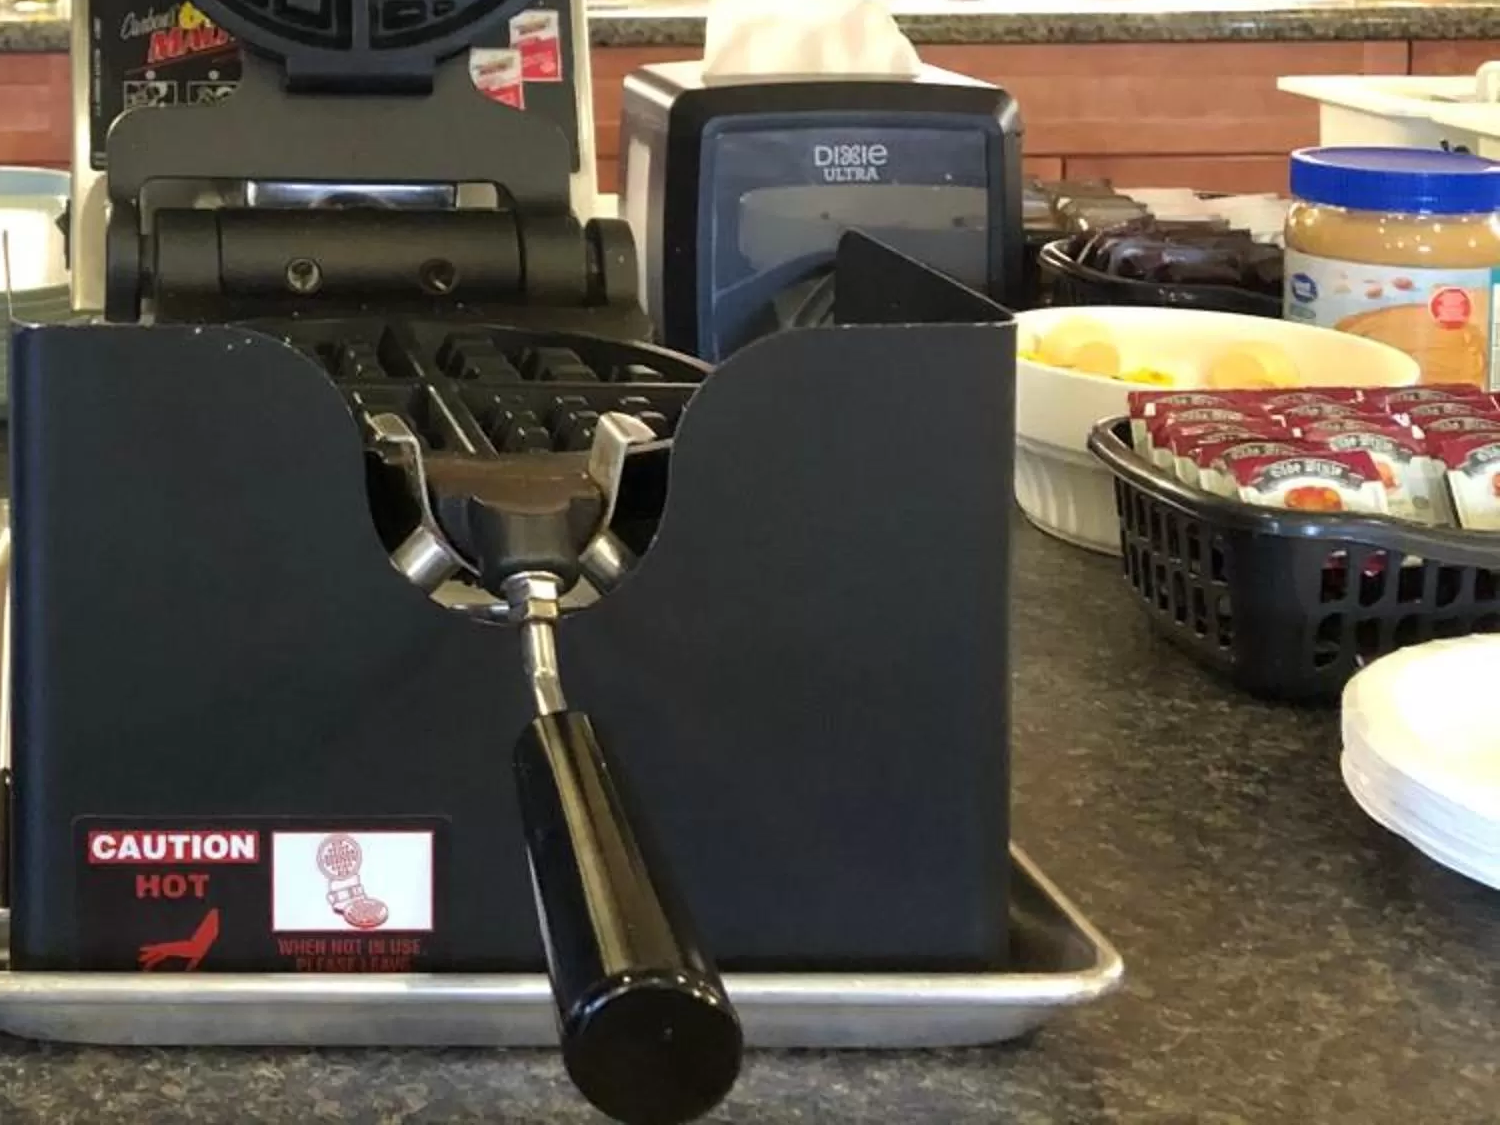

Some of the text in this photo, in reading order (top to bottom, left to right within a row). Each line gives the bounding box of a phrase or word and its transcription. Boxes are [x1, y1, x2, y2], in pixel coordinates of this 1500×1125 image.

[823, 166, 881, 182] ULTRA
[91, 833, 256, 861] CAUTION
[135, 873, 210, 900] HOT
[277, 938, 326, 956] WHEN
[331, 938, 362, 956] NOT
[368, 938, 385, 956] IN
